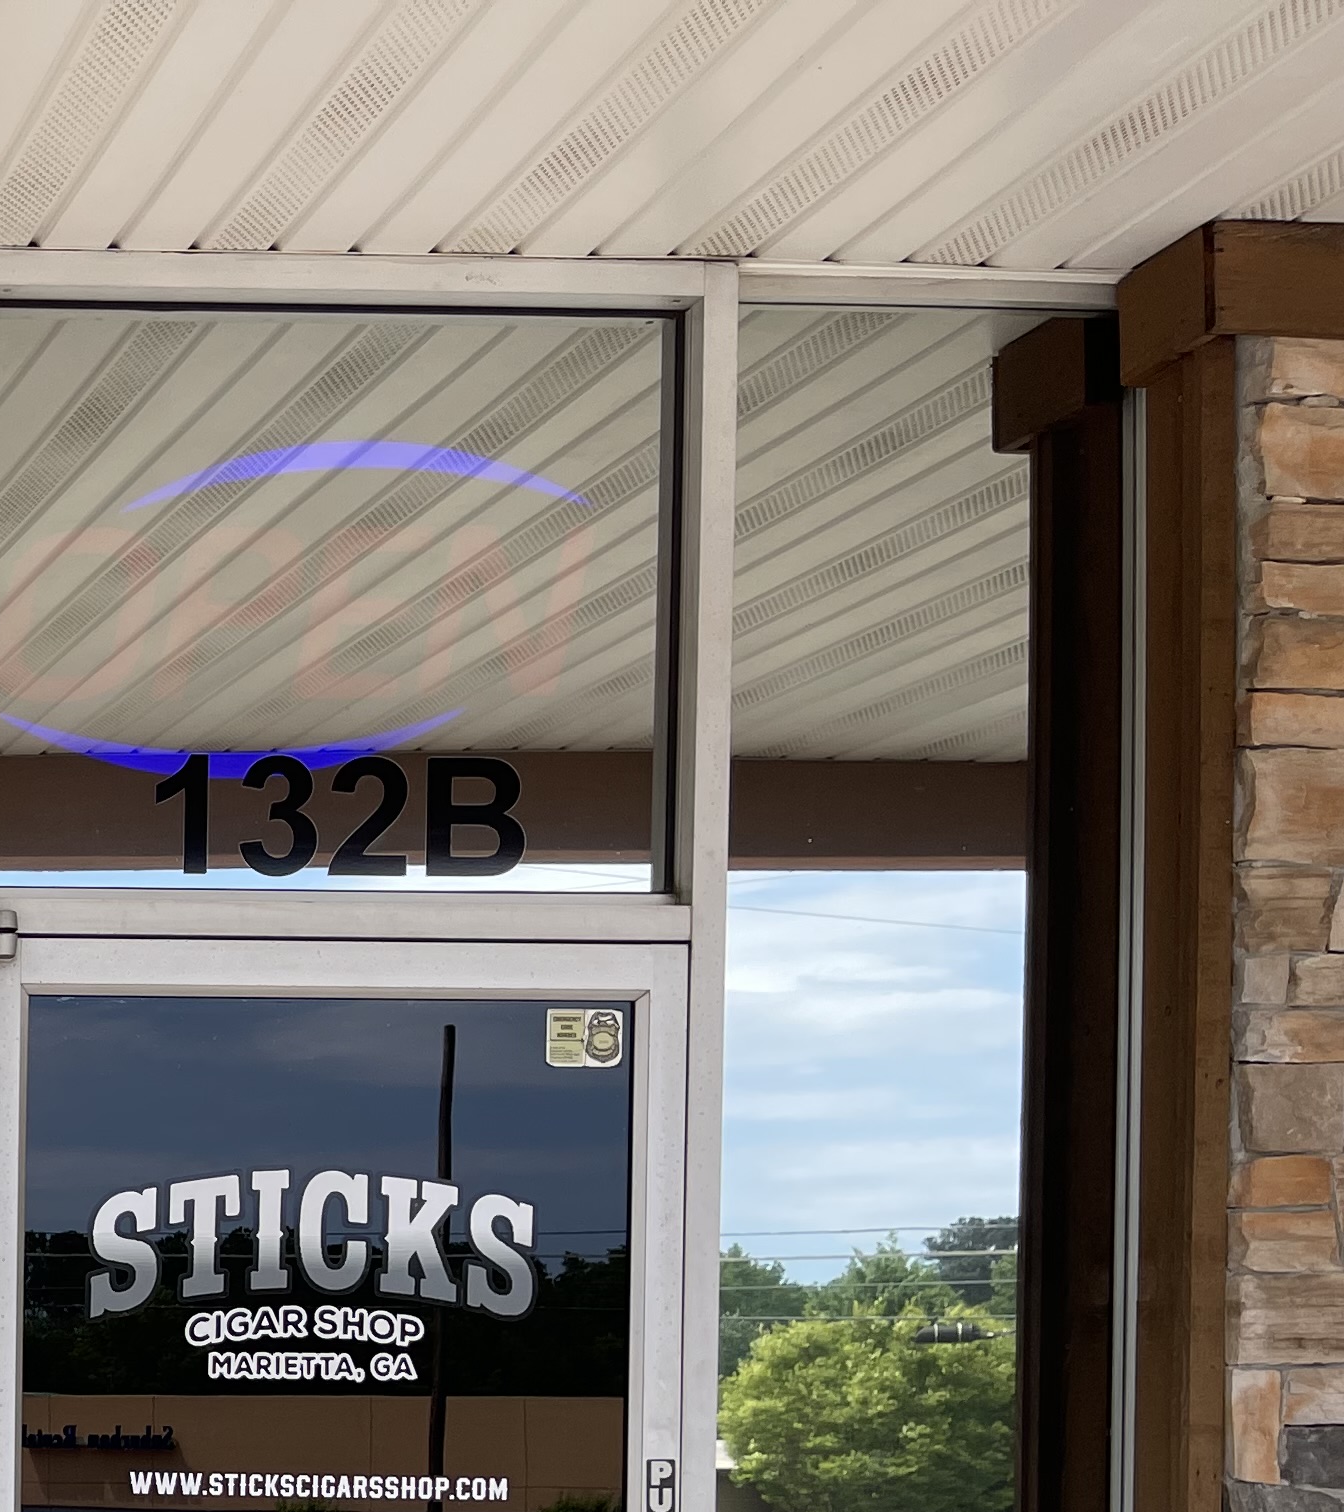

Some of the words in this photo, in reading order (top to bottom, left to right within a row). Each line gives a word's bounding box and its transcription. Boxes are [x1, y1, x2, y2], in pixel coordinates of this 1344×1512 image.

[154, 755, 528, 877] 132B
[88, 1167, 538, 1320] STICKS
[185, 1307, 306, 1346] CIGAR
[313, 1306, 424, 1346] SHOP
[208, 1351, 364, 1383] MARIETTA,
[371, 1354, 417, 1381] GA
[130, 1471, 510, 1501] WWW.STICKSCIGARSSHOP.COM
